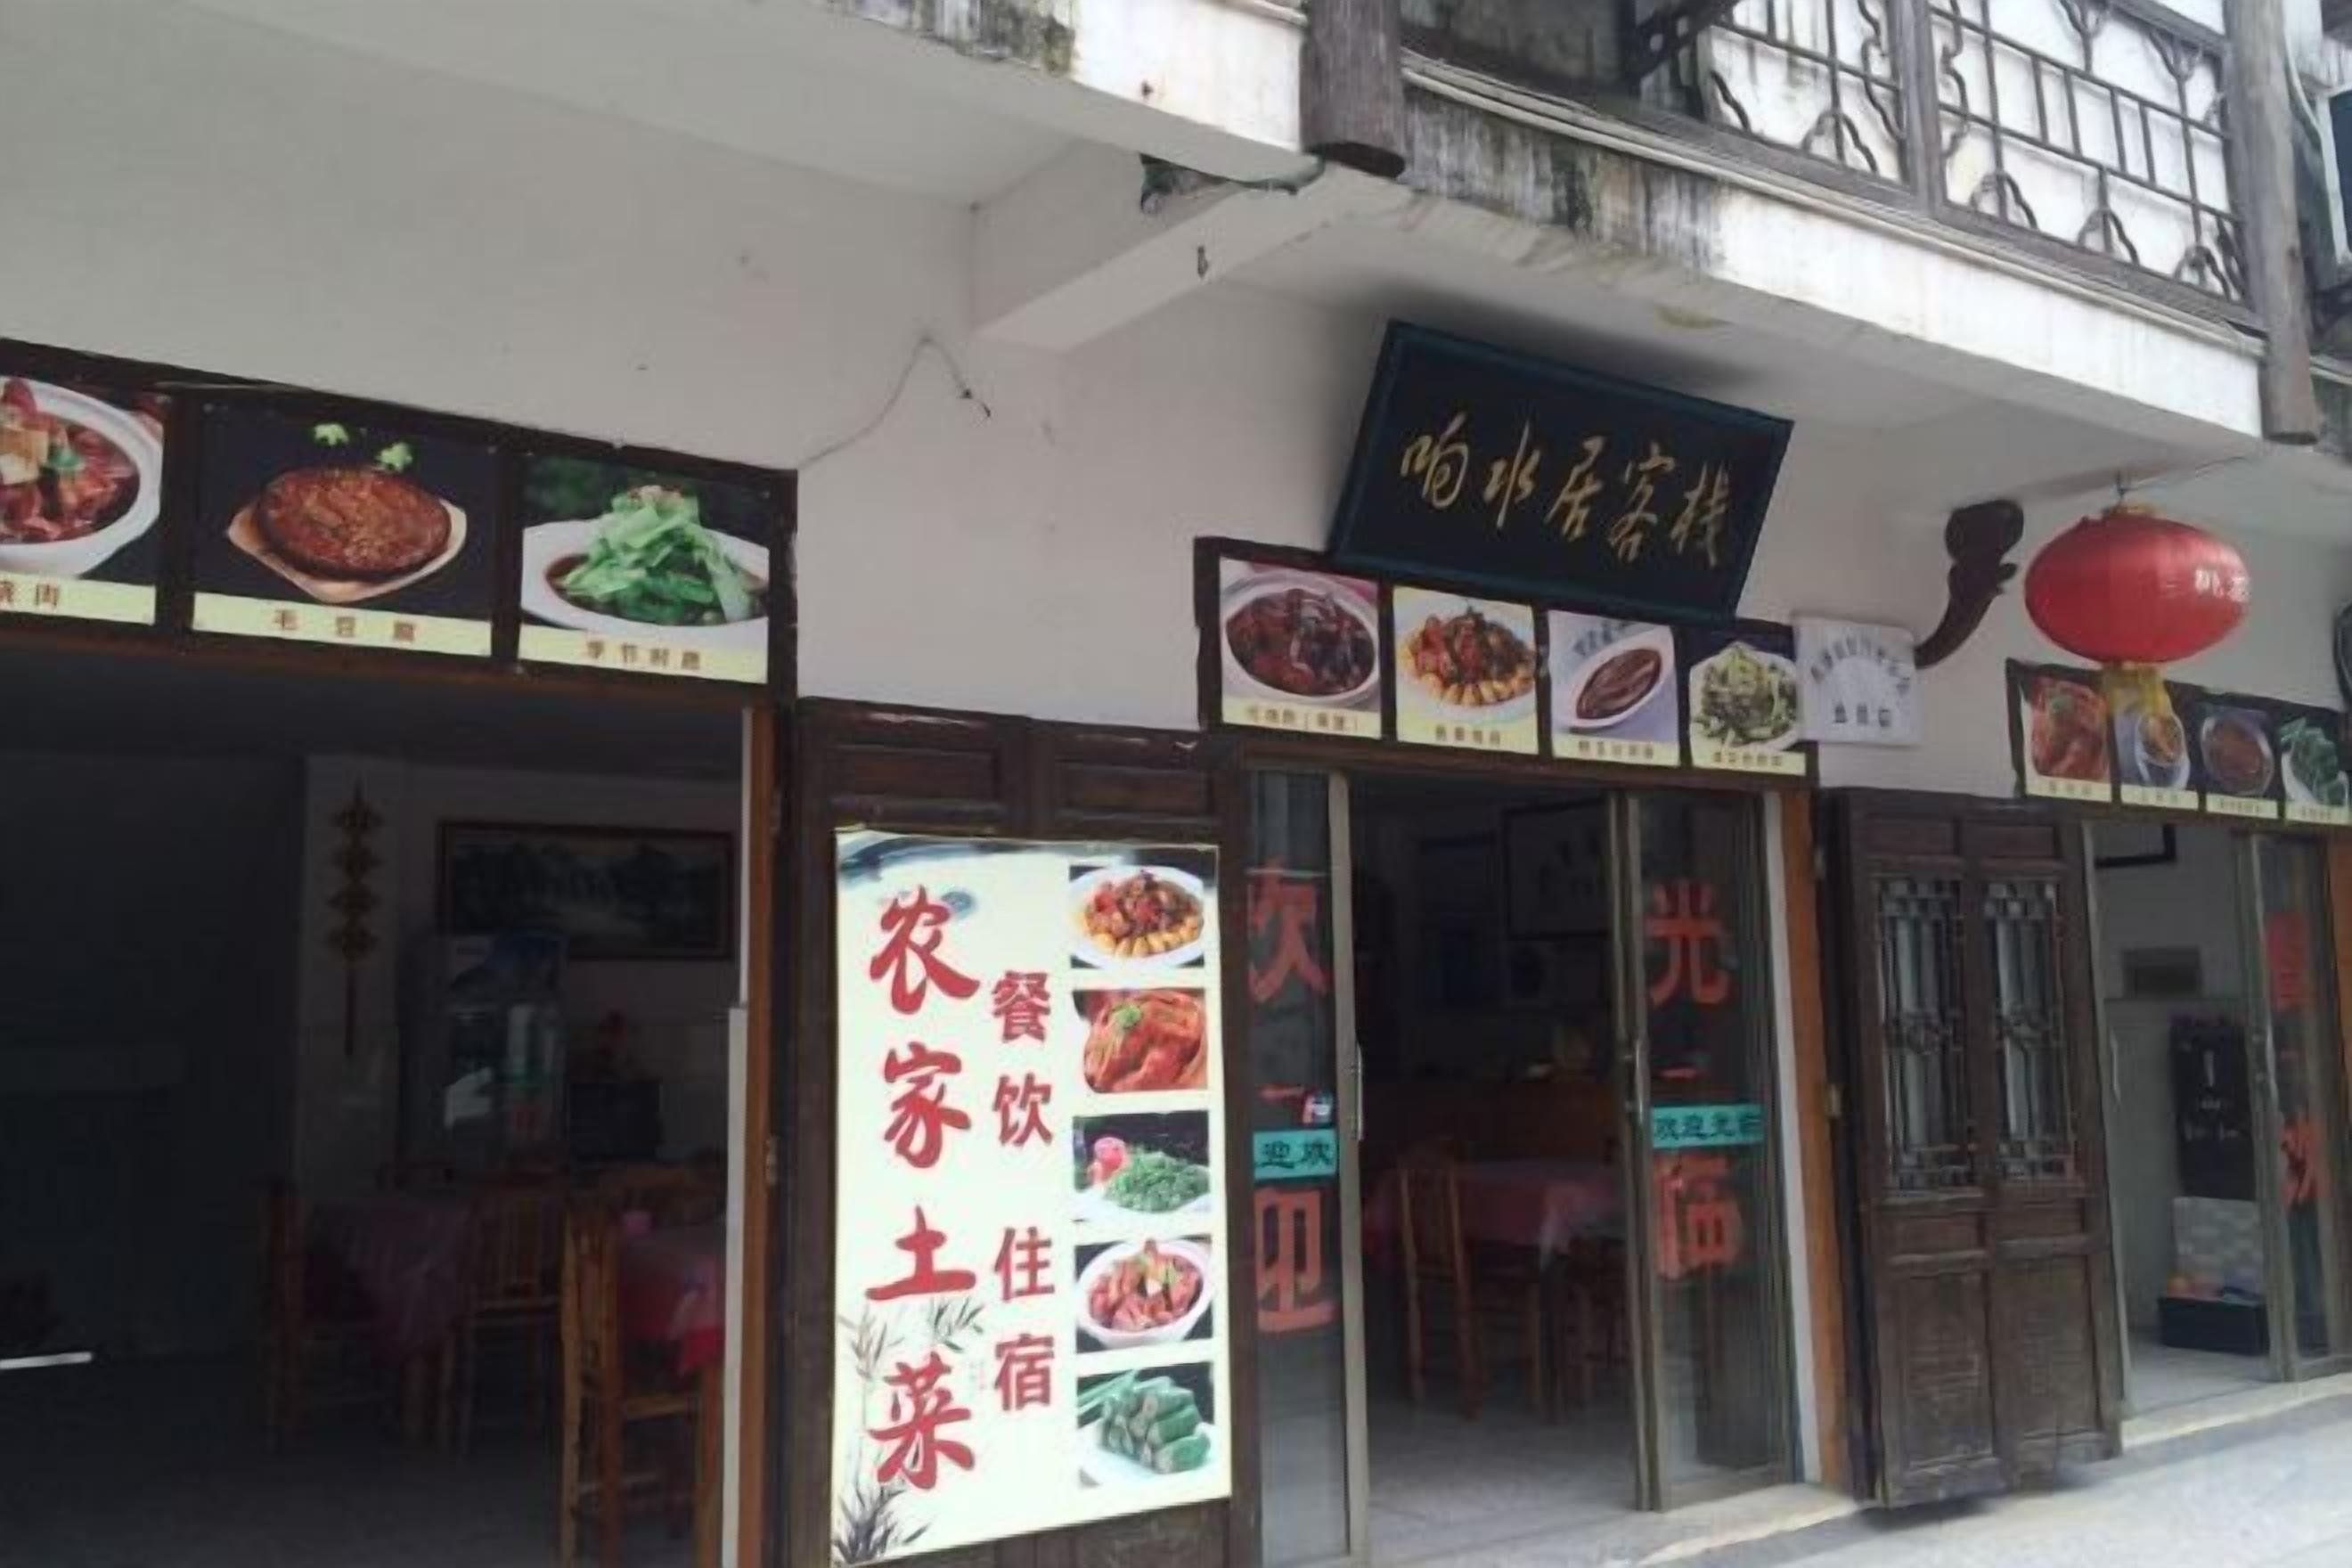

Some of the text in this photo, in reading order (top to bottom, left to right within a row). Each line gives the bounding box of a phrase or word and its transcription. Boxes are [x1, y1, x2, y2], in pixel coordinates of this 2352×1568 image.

[1401, 412, 1730, 568] 响水居客栈
[865, 885, 982, 1490] 农家土菜
[991, 969, 1057, 1413] 餐饮 住宿
